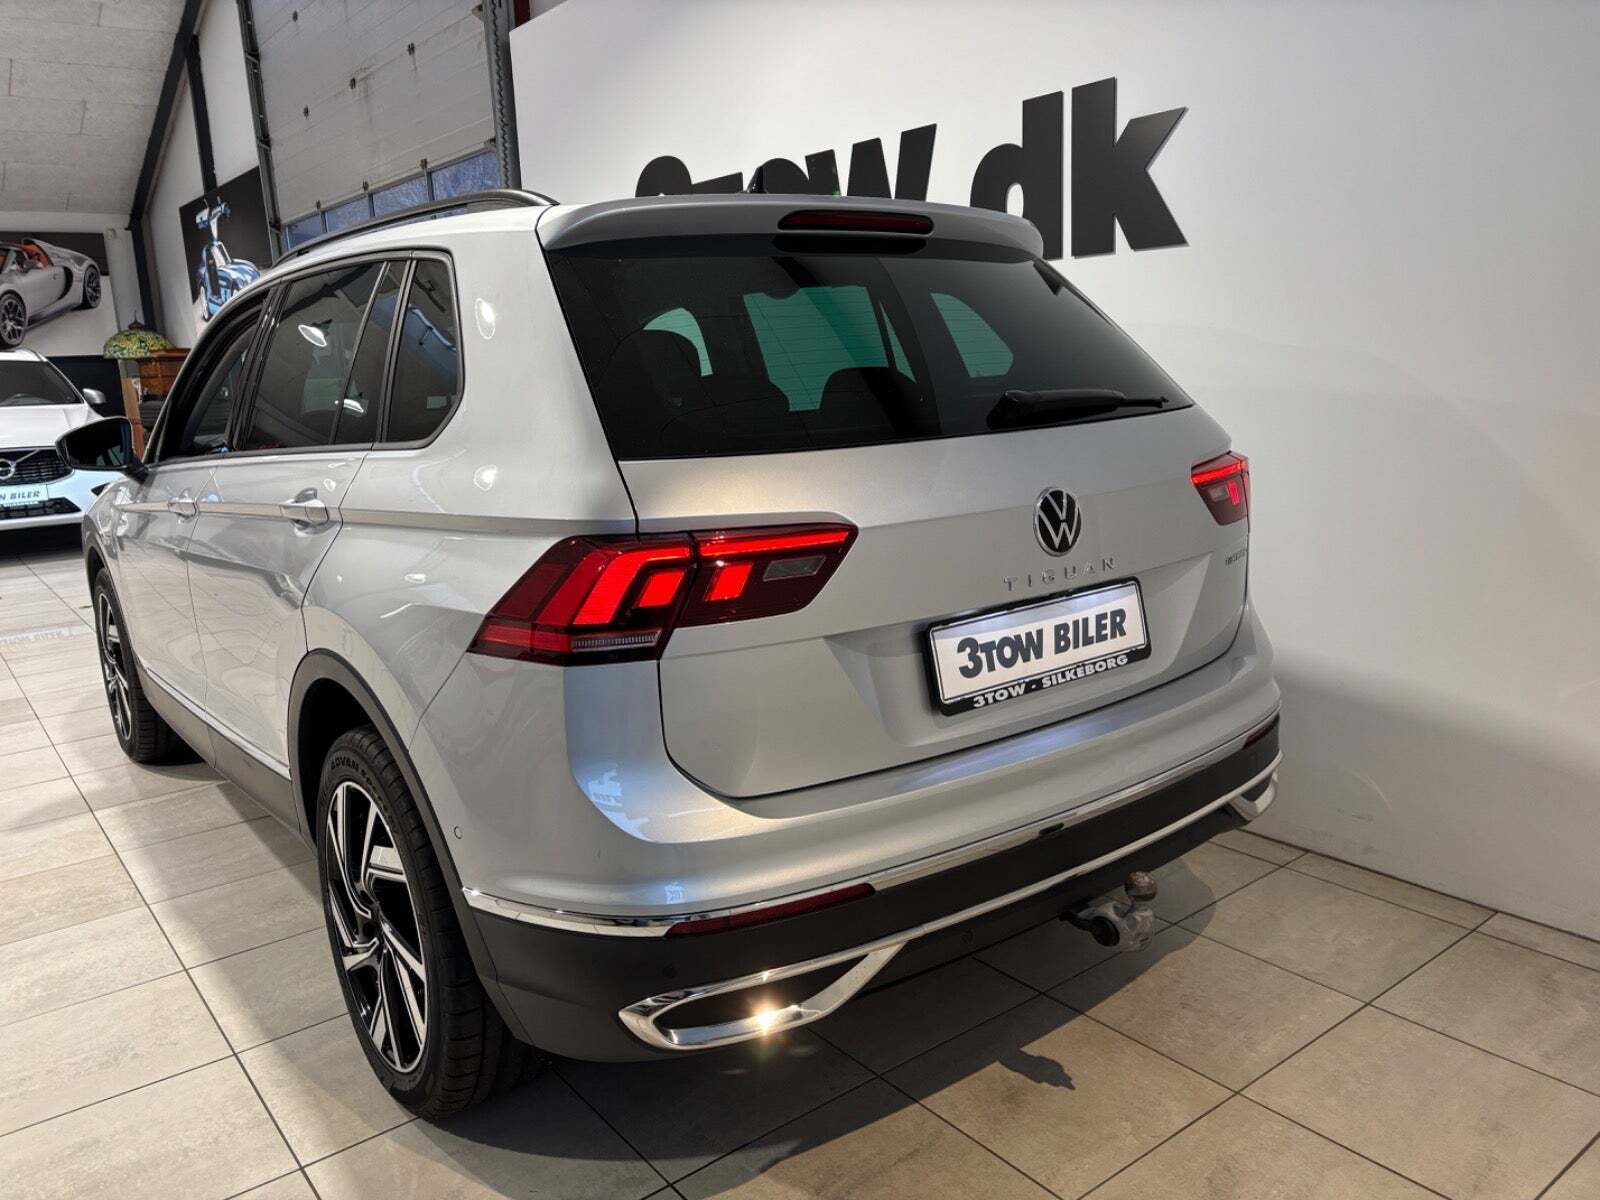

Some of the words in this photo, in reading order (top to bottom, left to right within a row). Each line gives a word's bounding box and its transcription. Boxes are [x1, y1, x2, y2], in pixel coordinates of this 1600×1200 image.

[1003, 557, 1117, 591] TIGUAN
[957, 629, 1044, 679] 3TOW
[1054, 608, 1127, 655] BILER
[973, 683, 1026, 708] 3TOW
[1041, 654, 1129, 689] SILKEBORG
